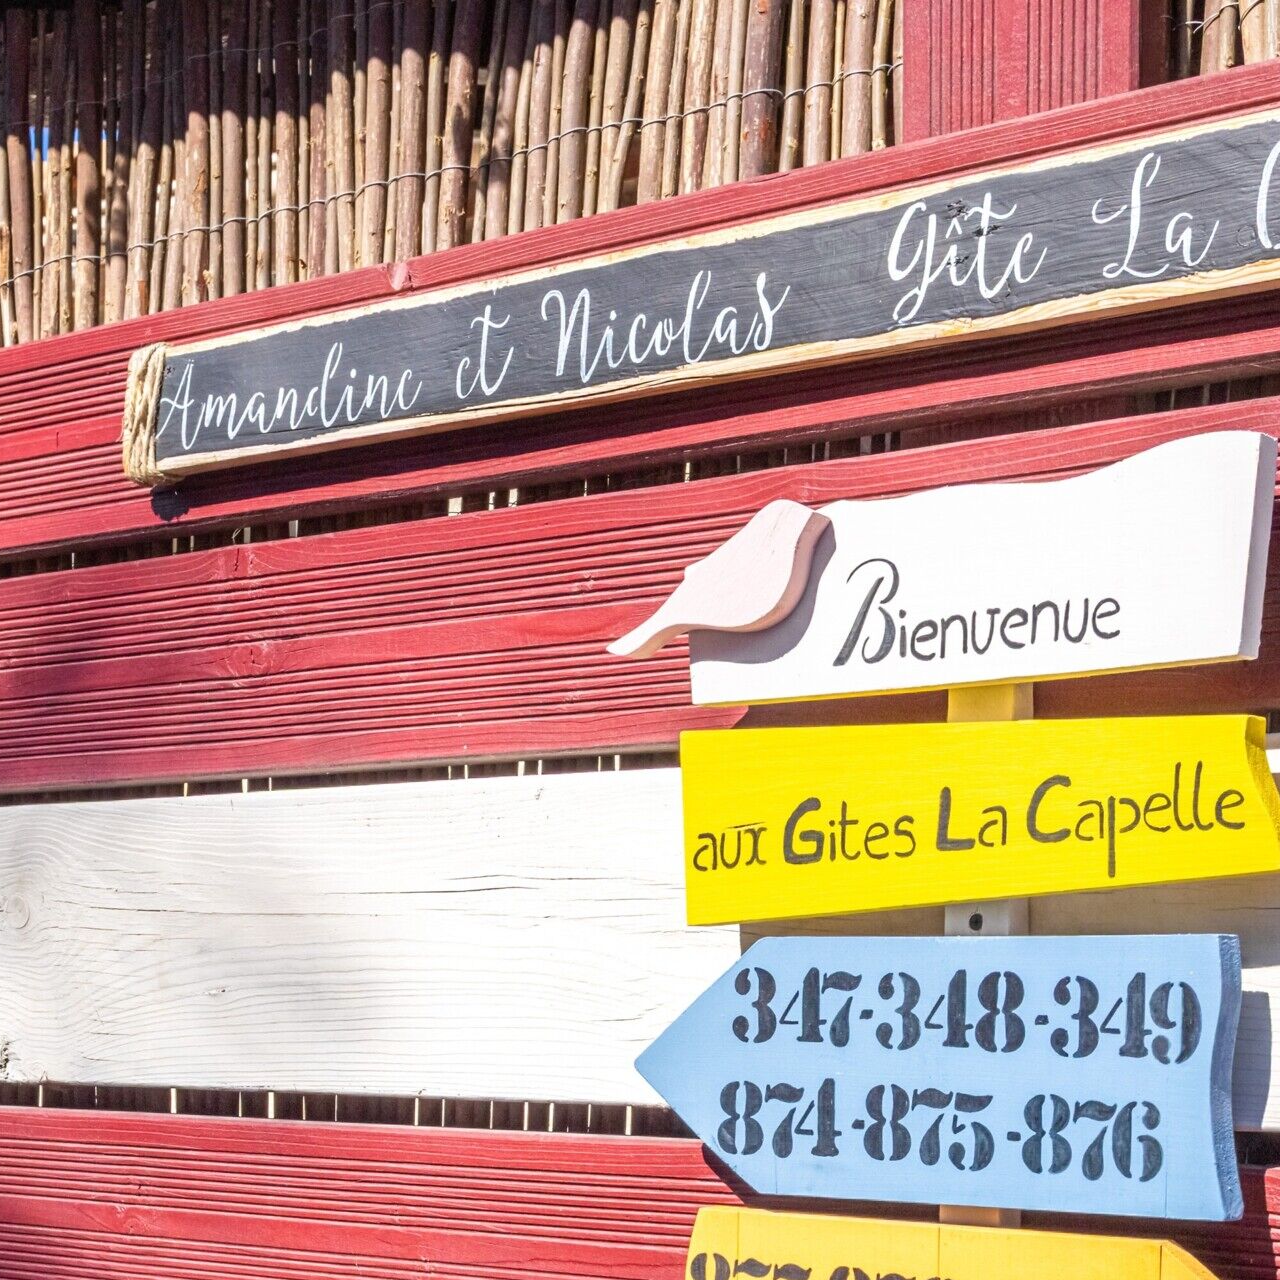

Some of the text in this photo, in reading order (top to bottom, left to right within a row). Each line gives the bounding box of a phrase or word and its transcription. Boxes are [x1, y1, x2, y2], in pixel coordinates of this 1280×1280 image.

[156, 342, 423, 450] Amandine
[455, 304, 514, 398] et
[541, 270, 791, 384] Nicolas
[887, 193, 1048, 328] Gîte
[1092, 152, 1220, 279] La
[832, 557, 1121, 668] Bienvenue
[693, 821, 767, 873] aux
[934, 786, 1008, 852] La
[1026, 760, 1246, 879] Capelle
[731, 966, 1202, 1065] 347-348-349
[718, 1077, 1164, 1183] 874-875-876
